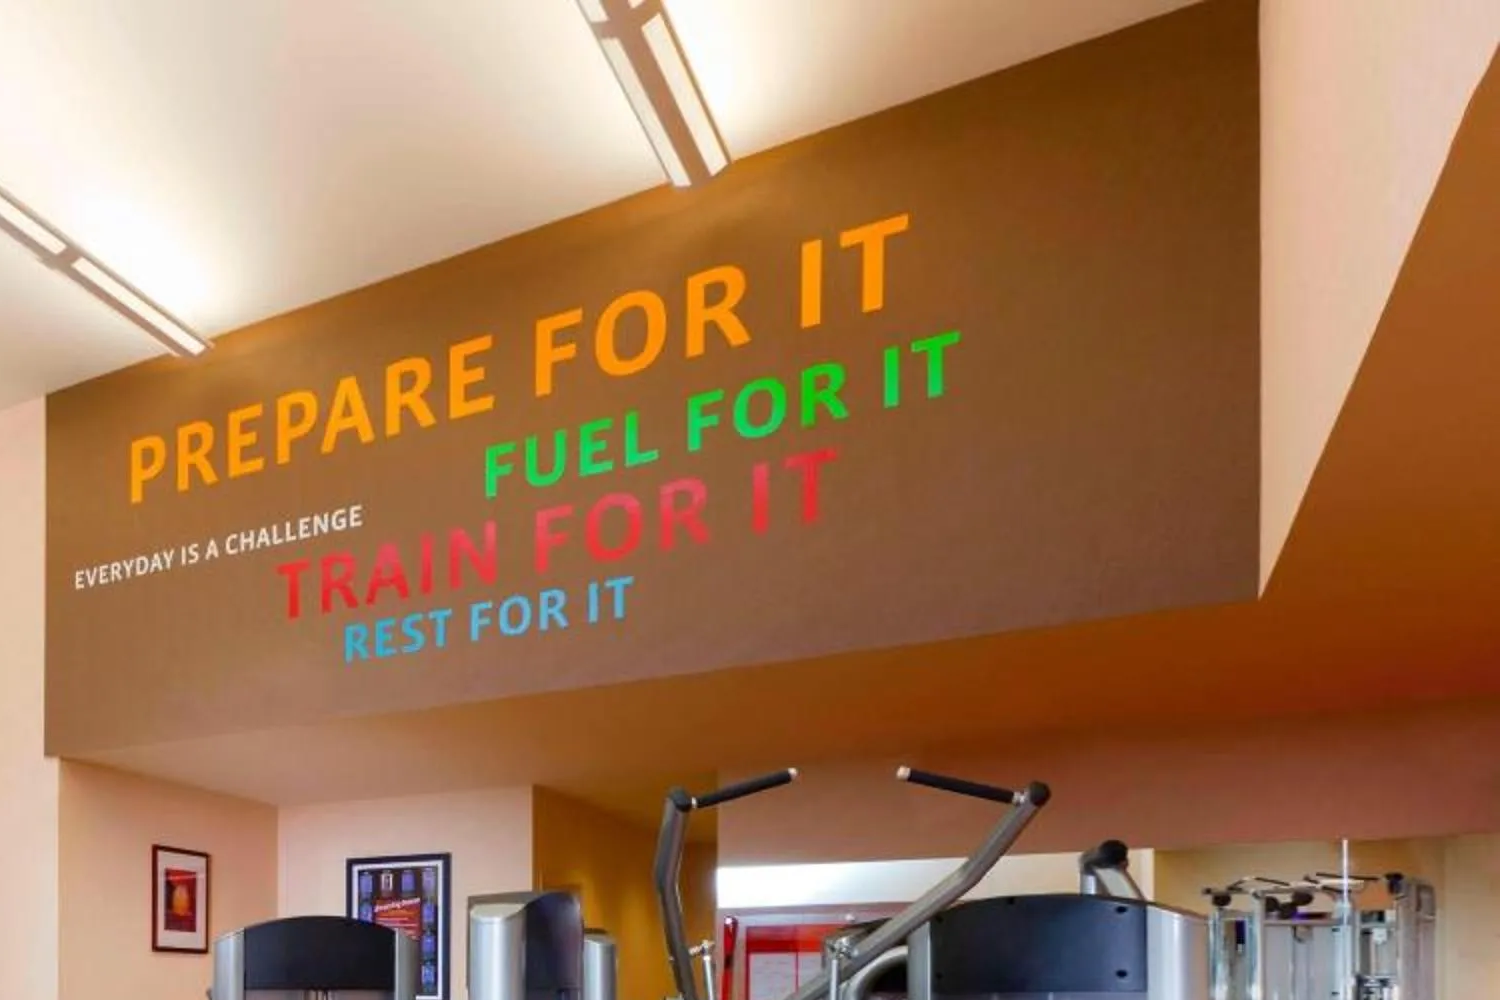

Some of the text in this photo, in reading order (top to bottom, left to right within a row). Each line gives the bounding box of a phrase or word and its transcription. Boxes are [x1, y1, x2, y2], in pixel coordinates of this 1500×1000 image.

[130, 213, 909, 504] PREPARE FOR IT
[484, 330, 961, 498] FUEL FOR IT
[74, 505, 364, 590] EVERYDAY IS A CHALLENGE
[276, 448, 838, 619] TRAIN FOR IT
[343, 575, 634, 663] REST FOR IT
